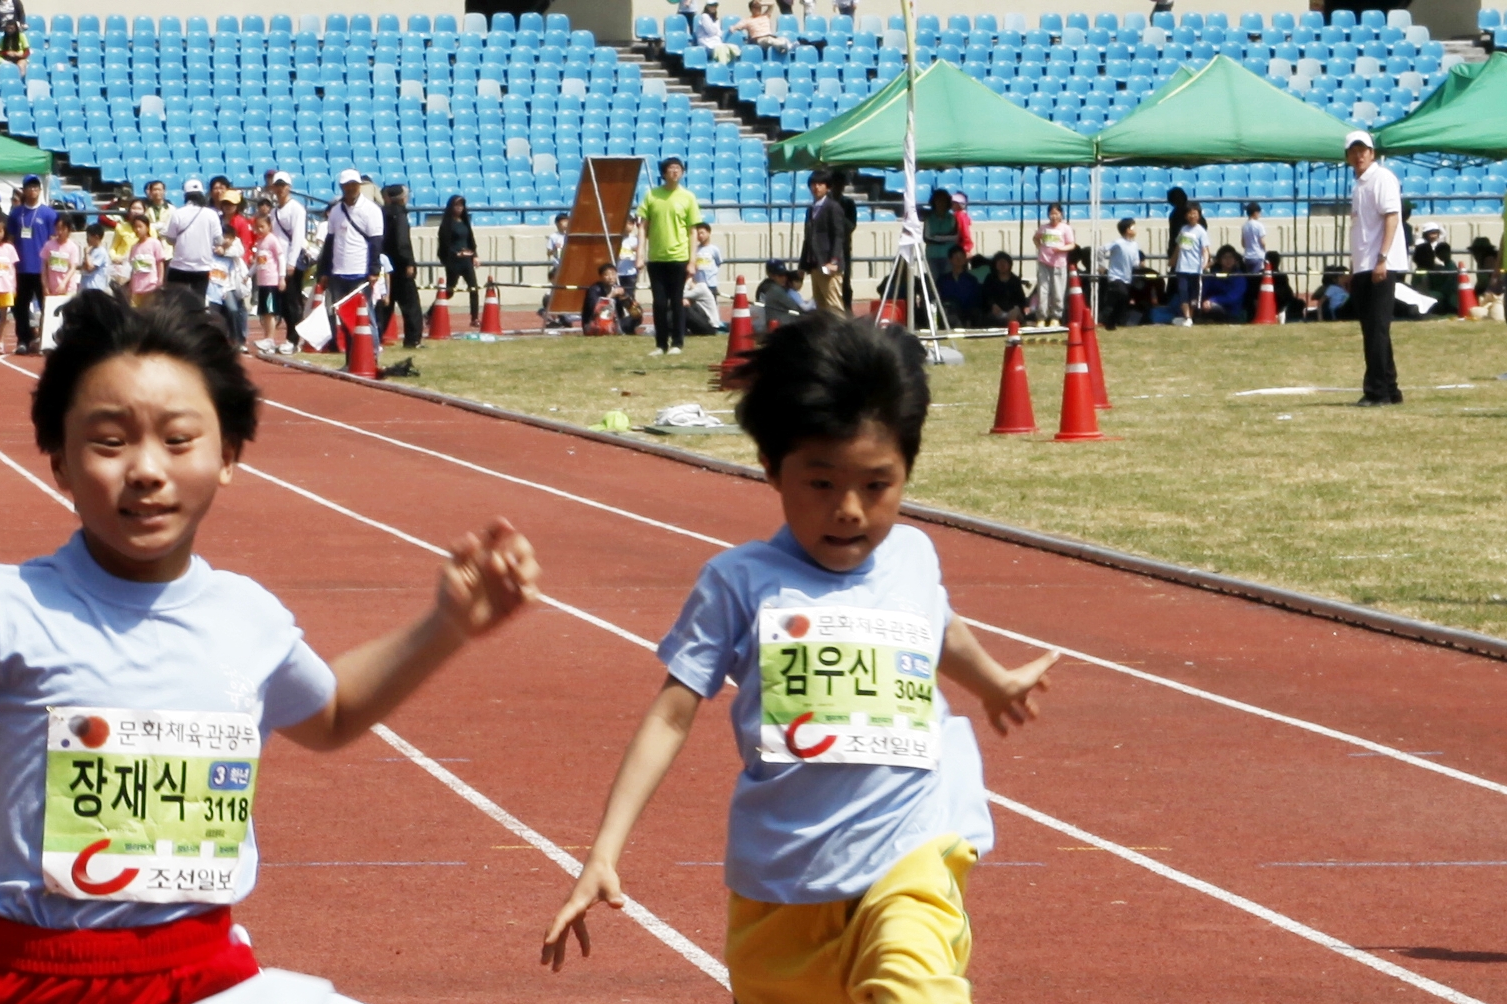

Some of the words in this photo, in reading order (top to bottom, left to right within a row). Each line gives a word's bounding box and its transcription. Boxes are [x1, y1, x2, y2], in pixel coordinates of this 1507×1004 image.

[779, 645, 878, 697] 김우신
[116, 719, 256, 751] 문화체육관광부
[844, 734, 930, 759] 조선일보
[214, 765, 226, 785] 3
[68, 756, 188, 822] 장재식
[203, 796, 249, 822] 3118
[146, 867, 234, 892] 조선일보
